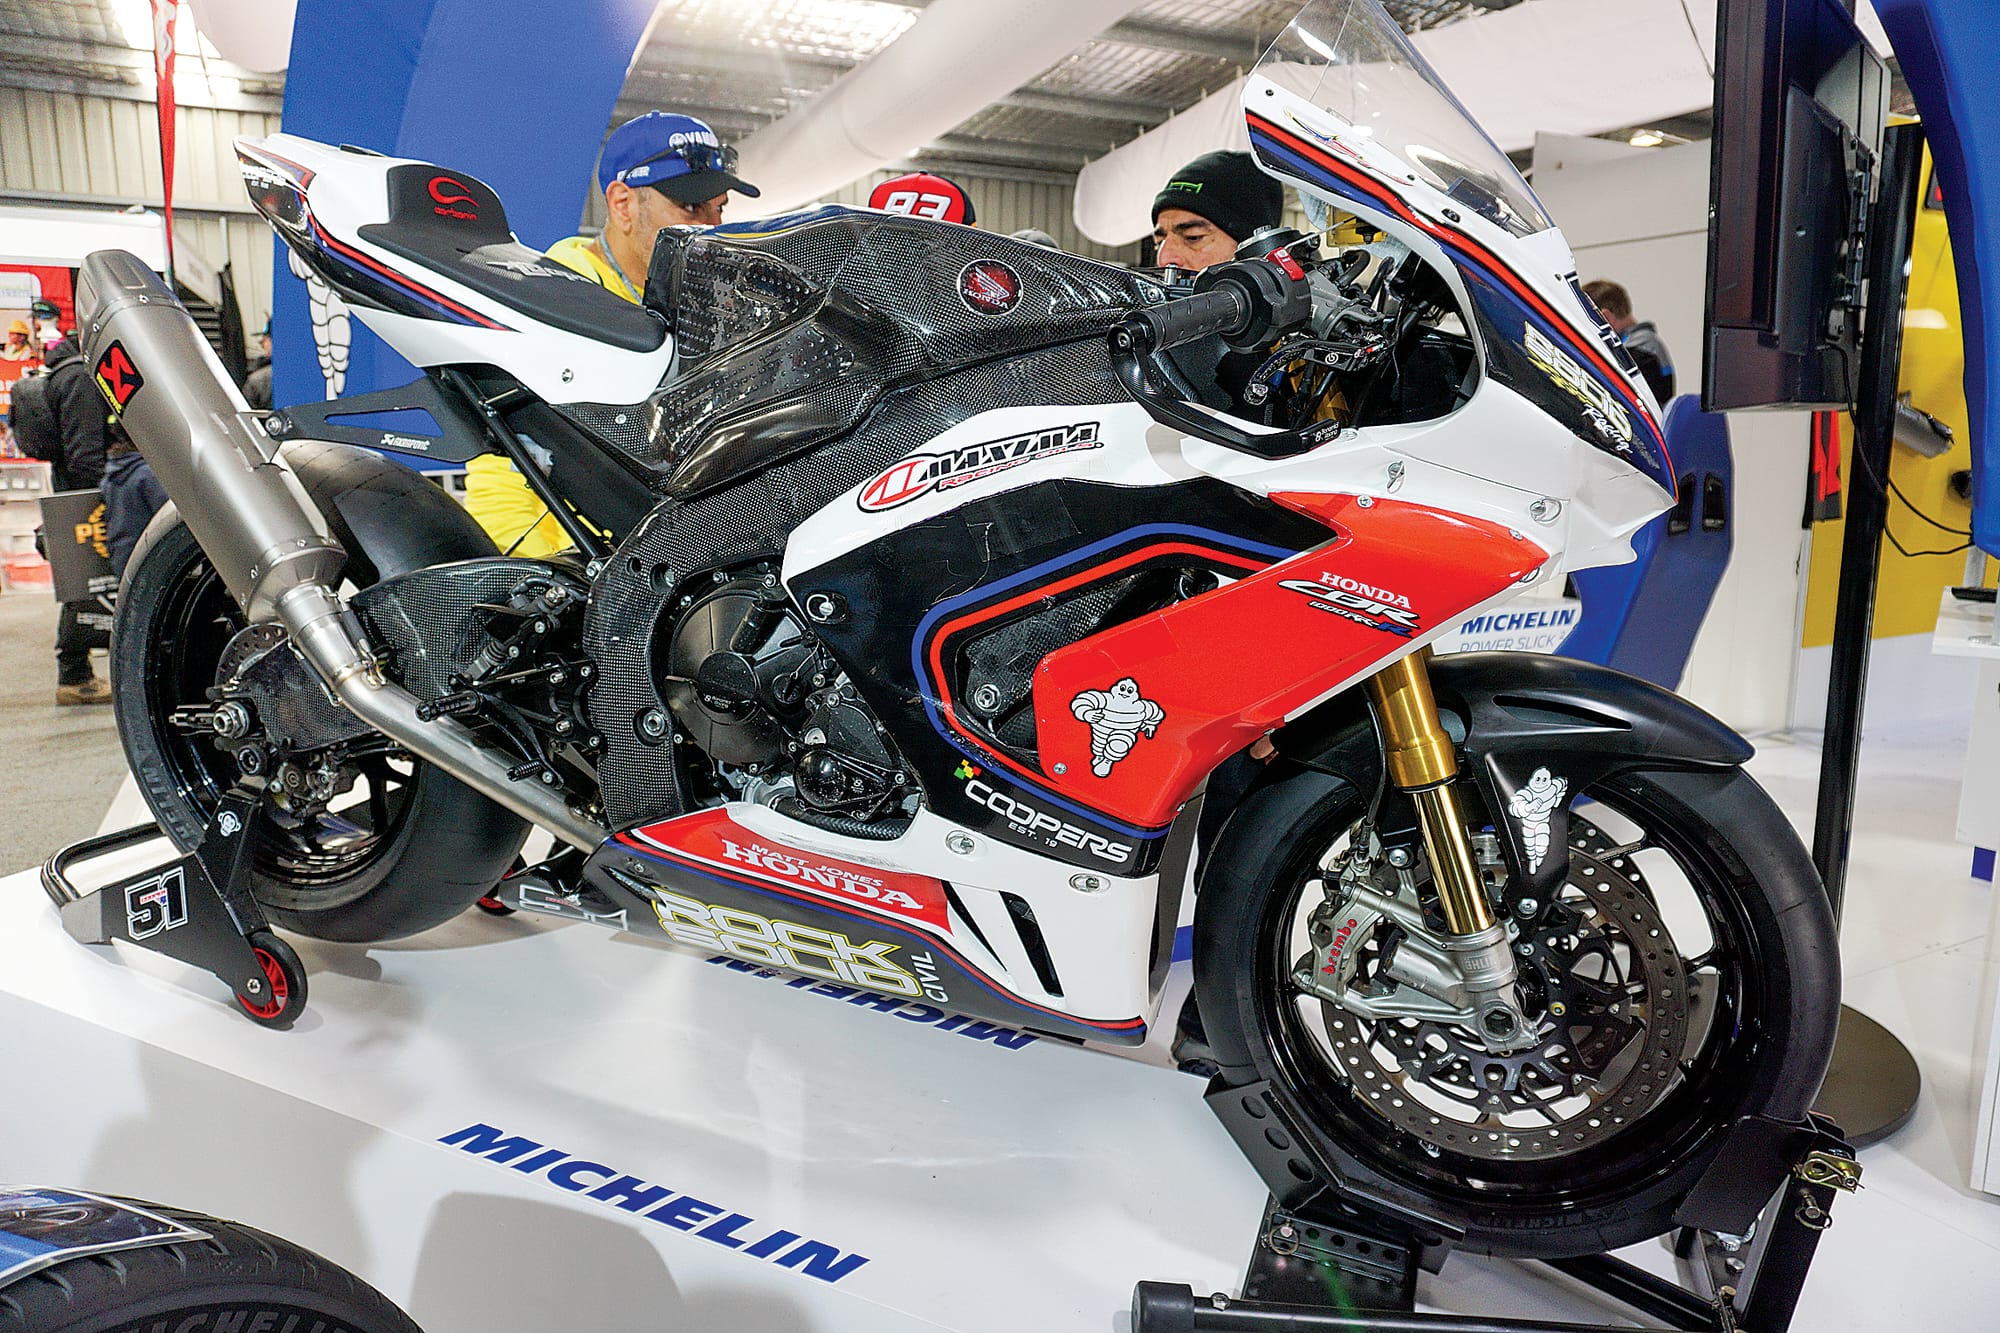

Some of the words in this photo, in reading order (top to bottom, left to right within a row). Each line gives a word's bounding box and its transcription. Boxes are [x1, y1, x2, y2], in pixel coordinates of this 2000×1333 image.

[884, 191, 952, 221] 93
[963, 288, 1010, 310] HONDA
[1582, 403, 1633, 453] Racing
[939, 456, 1031, 490] RACING
[1278, 579, 1421, 630] CBR
[1319, 571, 1412, 609] HONDA
[1460, 608, 1577, 636] MICHELIN
[1515, 634, 1556, 650] SLICK
[965, 779, 1133, 863] COOPERS
[1008, 822, 1038, 841] EST.
[1045, 837, 1059, 848] 19
[721, 839, 924, 910] HONDA
[750, 843, 810, 867] MATT
[816, 863, 885, 888] JONES
[124, 866, 189, 941] 51
[651, 886, 913, 977] ROCK
[1321, 918, 1358, 975] brembo
[659, 919, 924, 997] SOLID
[911, 951, 949, 1003] CIVIL
[437, 1122, 871, 1284] MICHELIN
